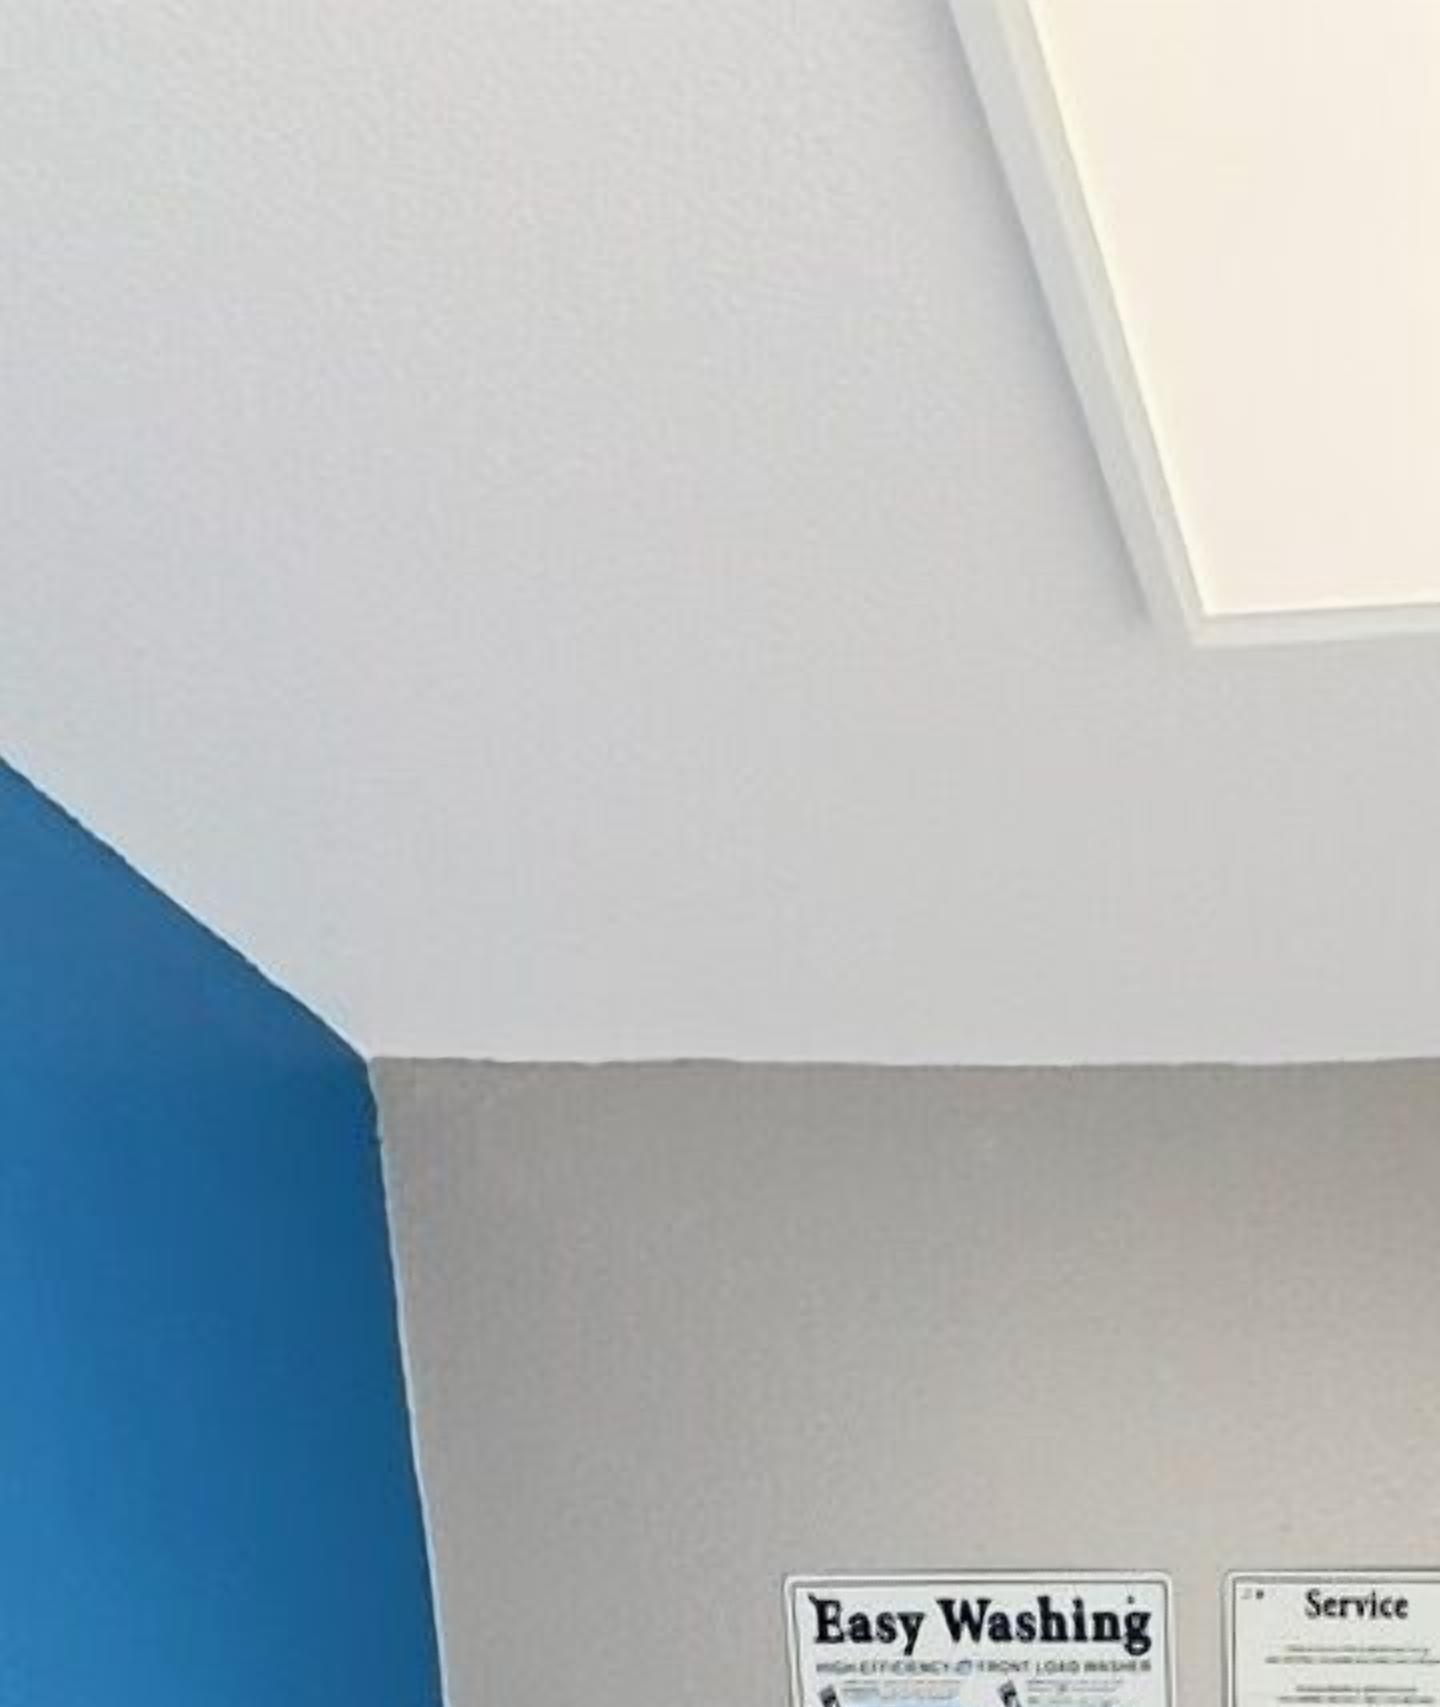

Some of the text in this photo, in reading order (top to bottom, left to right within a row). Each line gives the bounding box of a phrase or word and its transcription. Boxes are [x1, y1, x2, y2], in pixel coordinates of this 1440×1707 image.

[813, 1595, 1153, 1656] Easy Washing
[1304, 1587, 1409, 1620] Service
